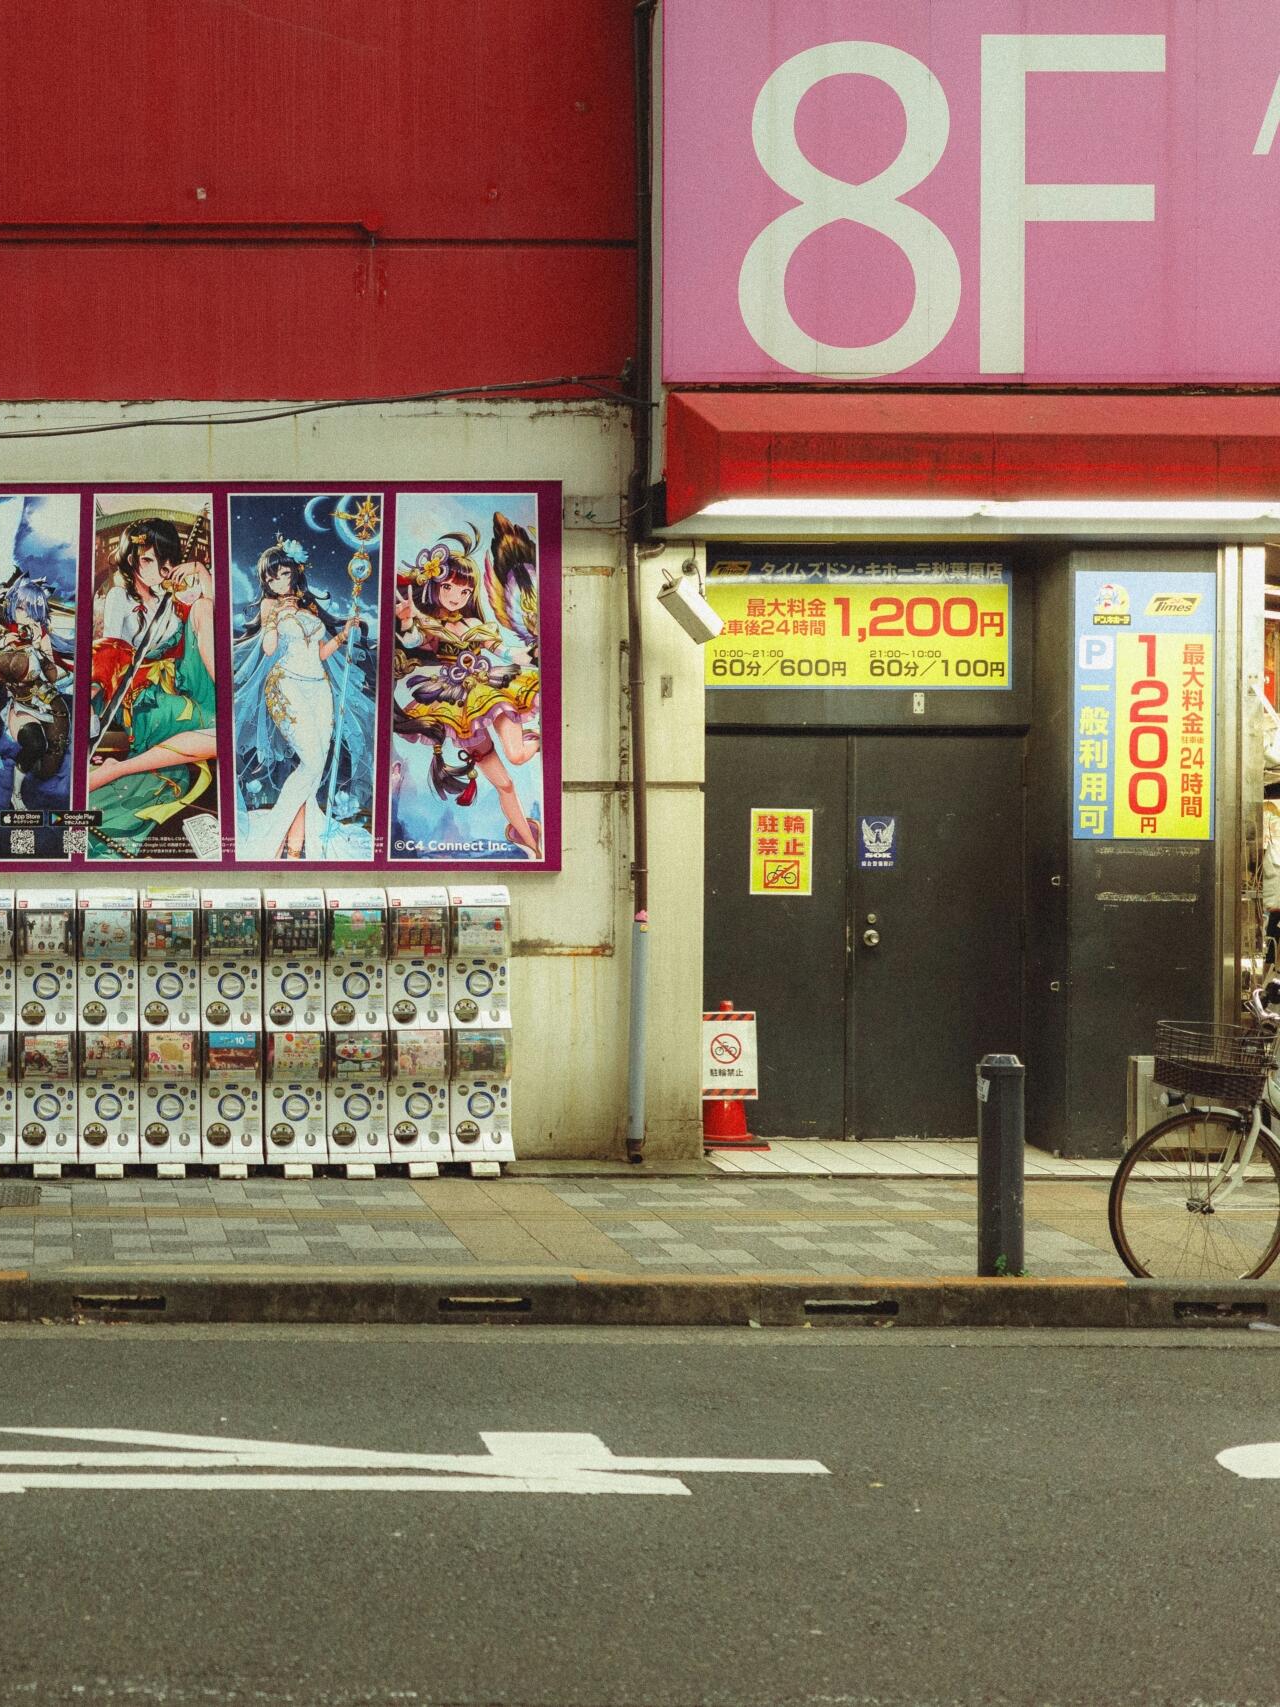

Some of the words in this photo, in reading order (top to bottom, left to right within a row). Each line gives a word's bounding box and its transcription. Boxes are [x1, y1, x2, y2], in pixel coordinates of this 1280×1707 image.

[738, 34, 1166, 380] 8F
[747, 598, 826, 618] 最大料金
[1155, 601, 1193, 612] Times
[833, 597, 1004, 643] 1,200円
[1079, 683, 1110, 836] 一般利用可
[13, 813, 24, 821] App
[757, 815, 806, 834] 駐輪
[428, 840, 485, 851] Connect
[488, 840, 512, 851] Inc.
[757, 838, 805, 856] 禁止
[709, 1068, 743, 1077] 駐輪禁止
